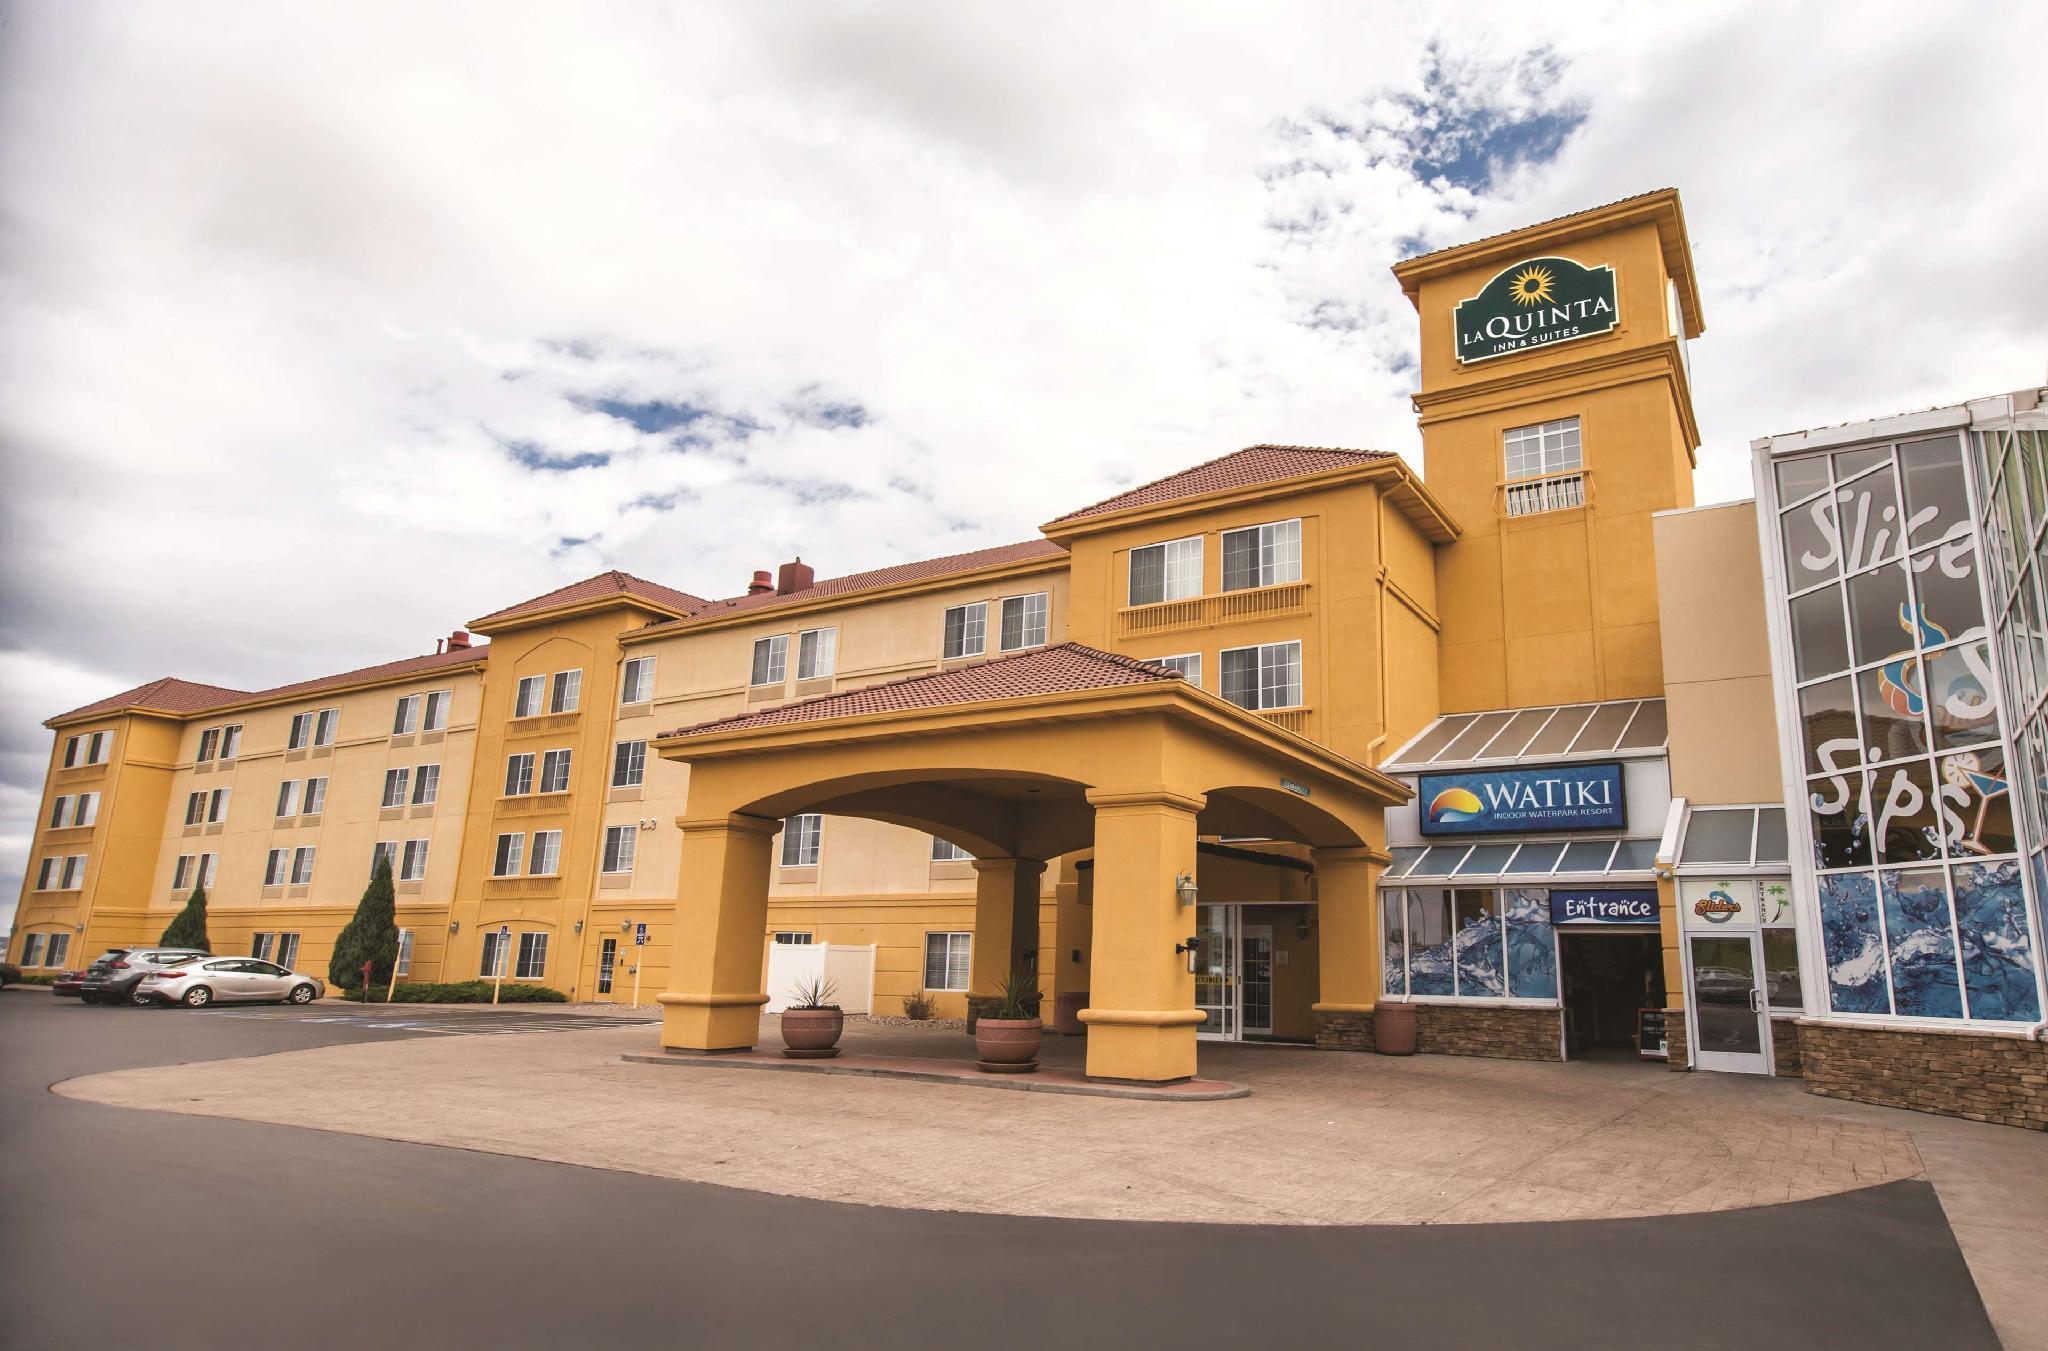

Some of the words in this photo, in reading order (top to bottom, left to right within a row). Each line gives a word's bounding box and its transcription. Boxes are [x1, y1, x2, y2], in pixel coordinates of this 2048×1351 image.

[1463, 330, 1484, 345] LA
[1485, 296, 1613, 339] QUINTA
[1493, 340, 1516, 353] INN
[1520, 339, 1527, 347] &
[1531, 326, 1580, 344] SUITES
[1800, 489, 1974, 580] Slice
[1810, 738, 1971, 853] Sips
[1494, 812, 1527, 820] INDOOR
[1528, 809, 1578, 818] WATERPARK
[1580, 807, 1613, 816] RESORT
[1565, 896, 1651, 918] Entrance
[1695, 899, 1742, 916] Sliders
